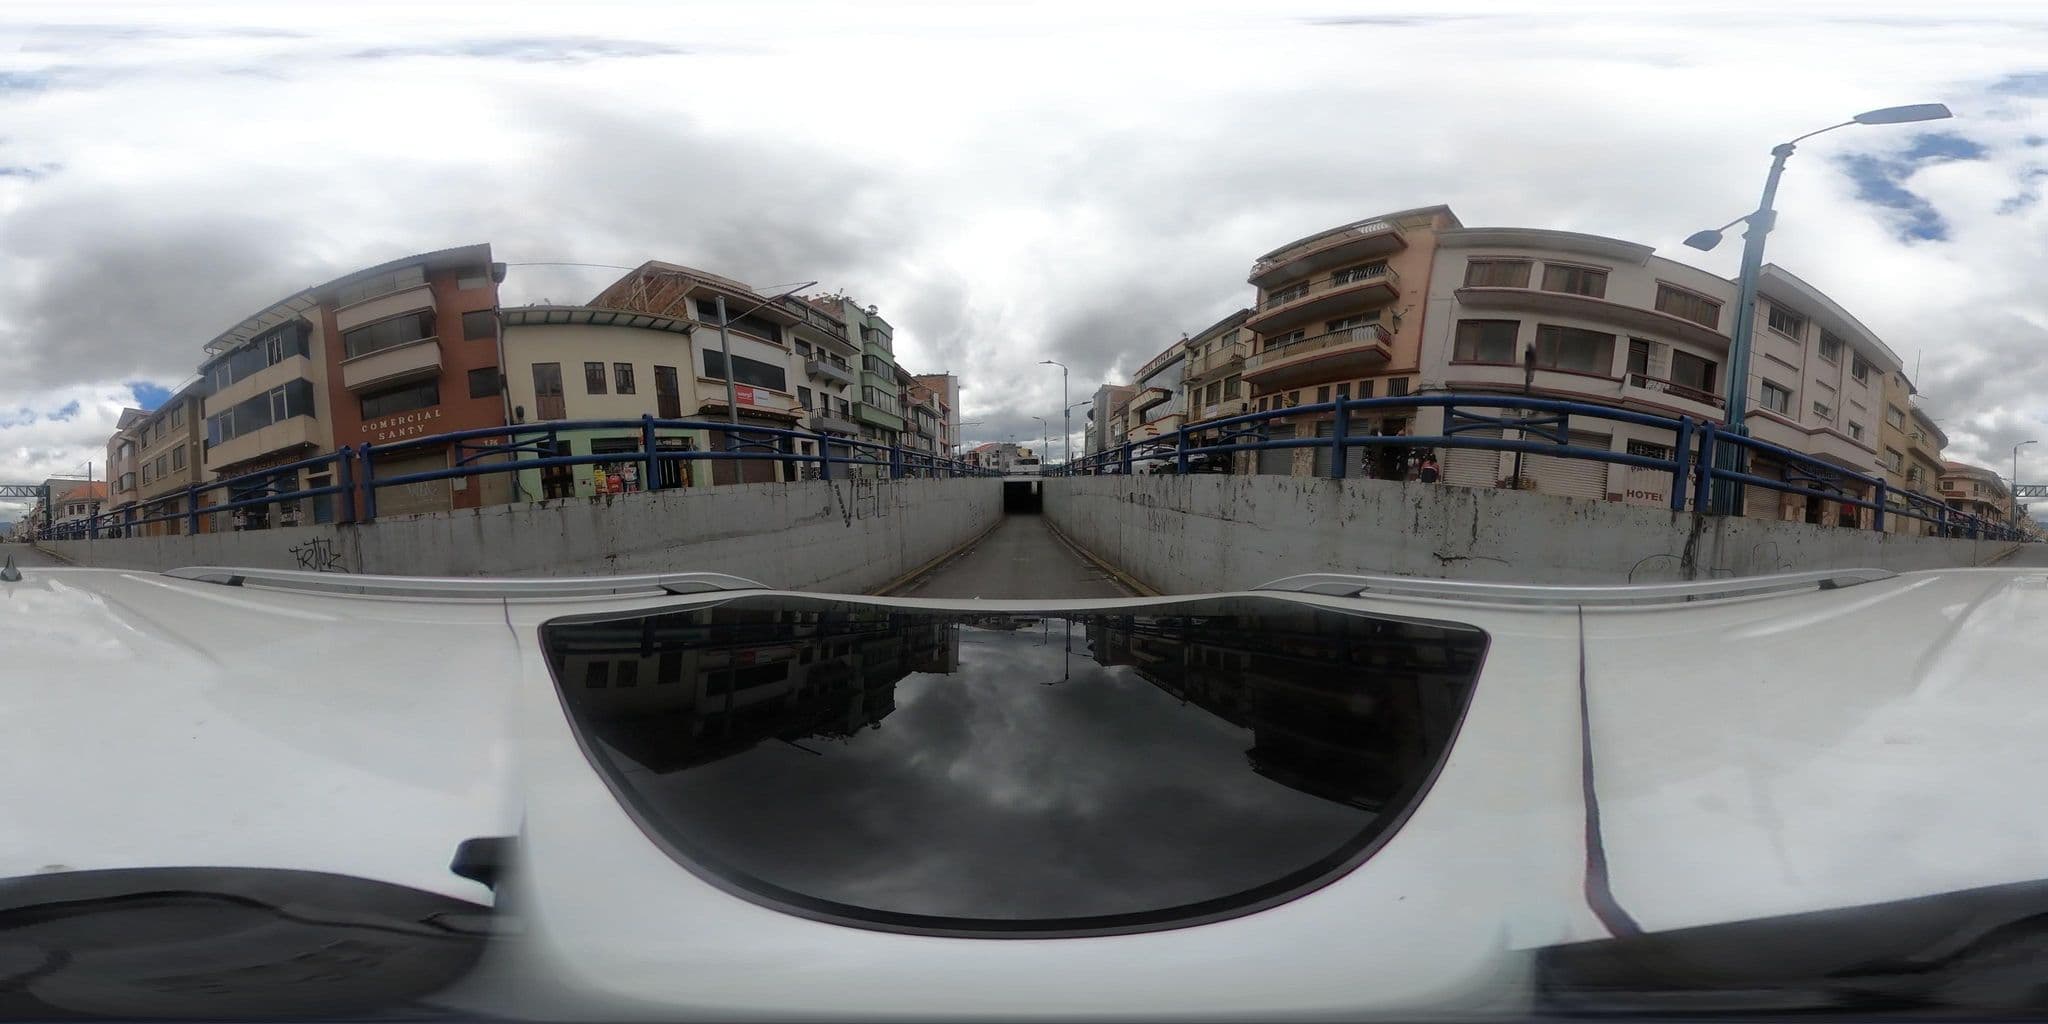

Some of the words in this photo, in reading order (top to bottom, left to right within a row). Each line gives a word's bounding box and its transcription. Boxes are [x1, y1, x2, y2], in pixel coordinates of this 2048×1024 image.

[361, 409, 441, 433] COMERCIAL
[378, 424, 425, 440] SANTY
[1626, 489, 1664, 502] HOTEL
